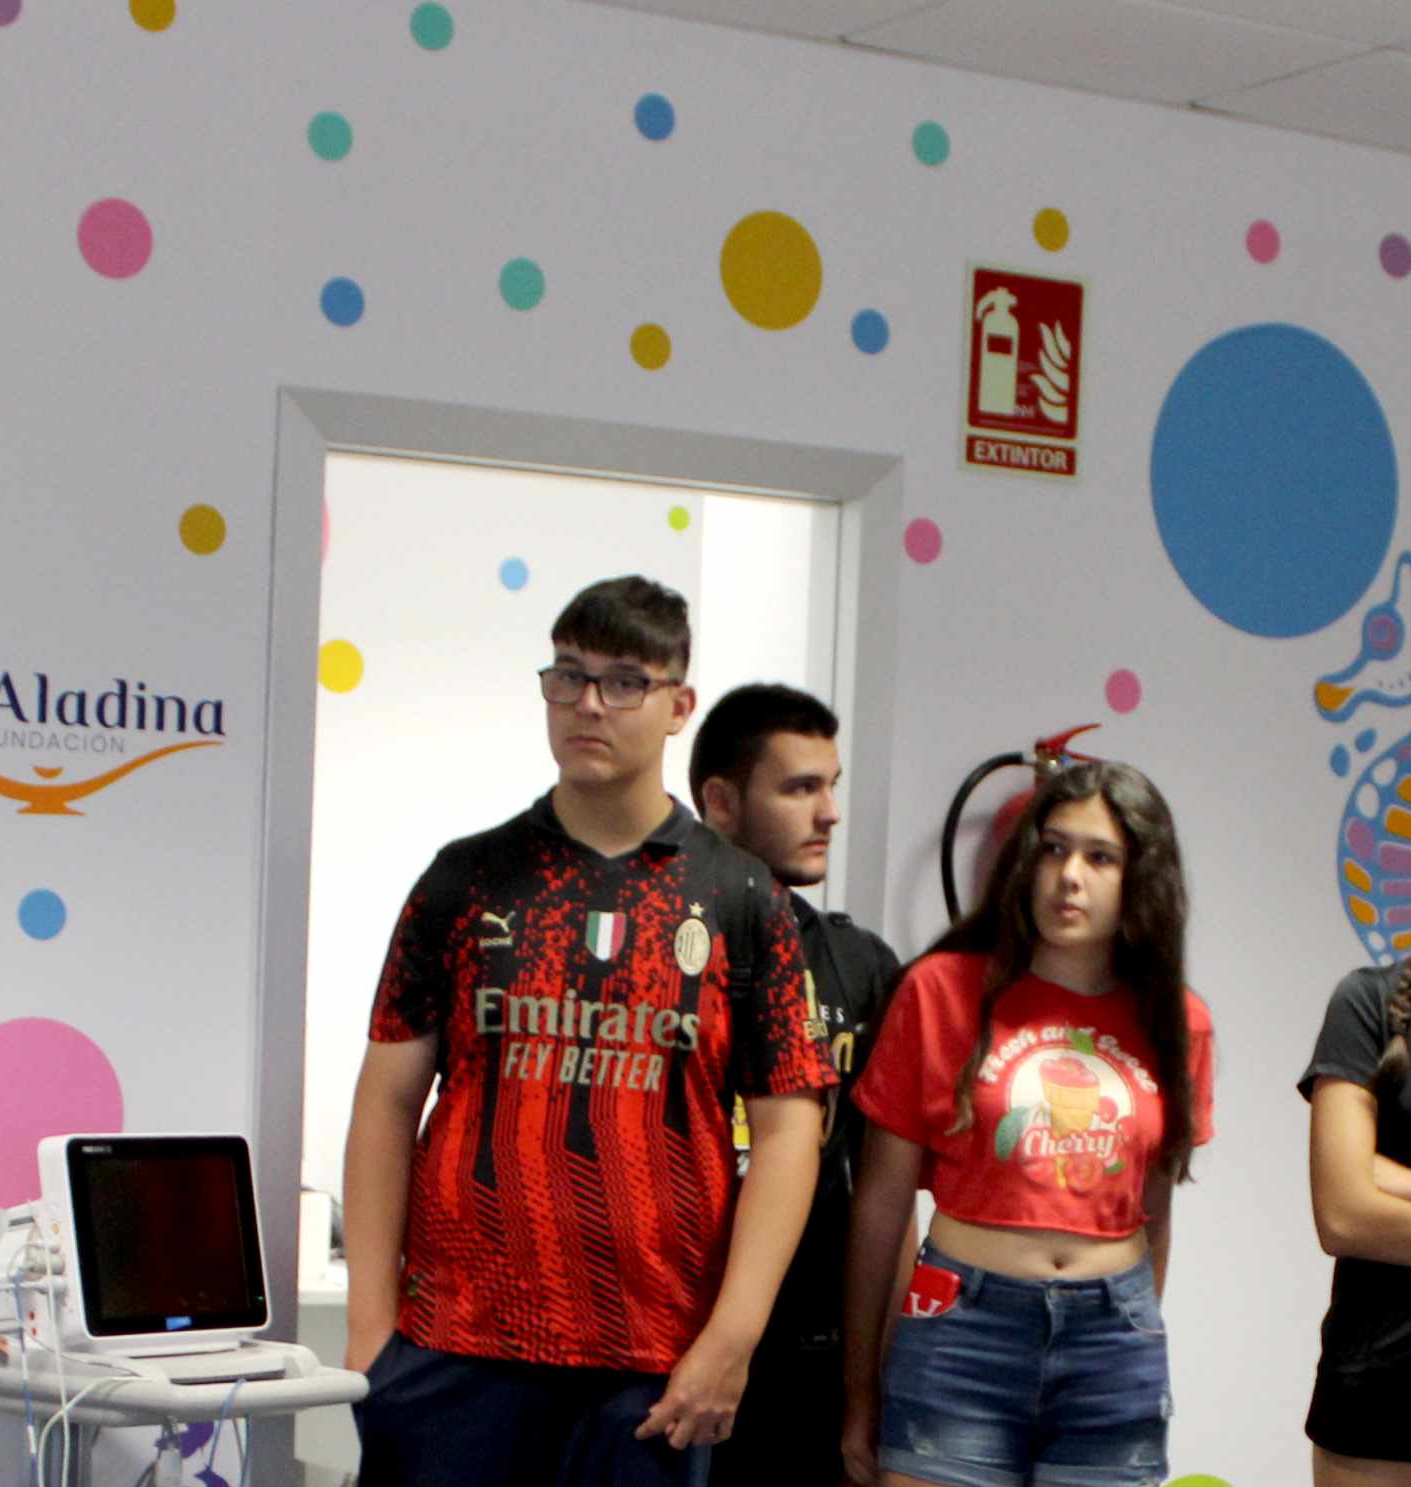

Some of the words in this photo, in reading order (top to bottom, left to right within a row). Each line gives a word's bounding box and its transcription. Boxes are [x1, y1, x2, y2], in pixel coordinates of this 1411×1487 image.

[973, 441, 1069, 471] EXTINTOR
[476, 987, 702, 1052] Emirates
[504, 1041, 554, 1081] FLY
[558, 1045, 665, 1094] BETTER
[1024, 1130, 1116, 1160] Cherry
